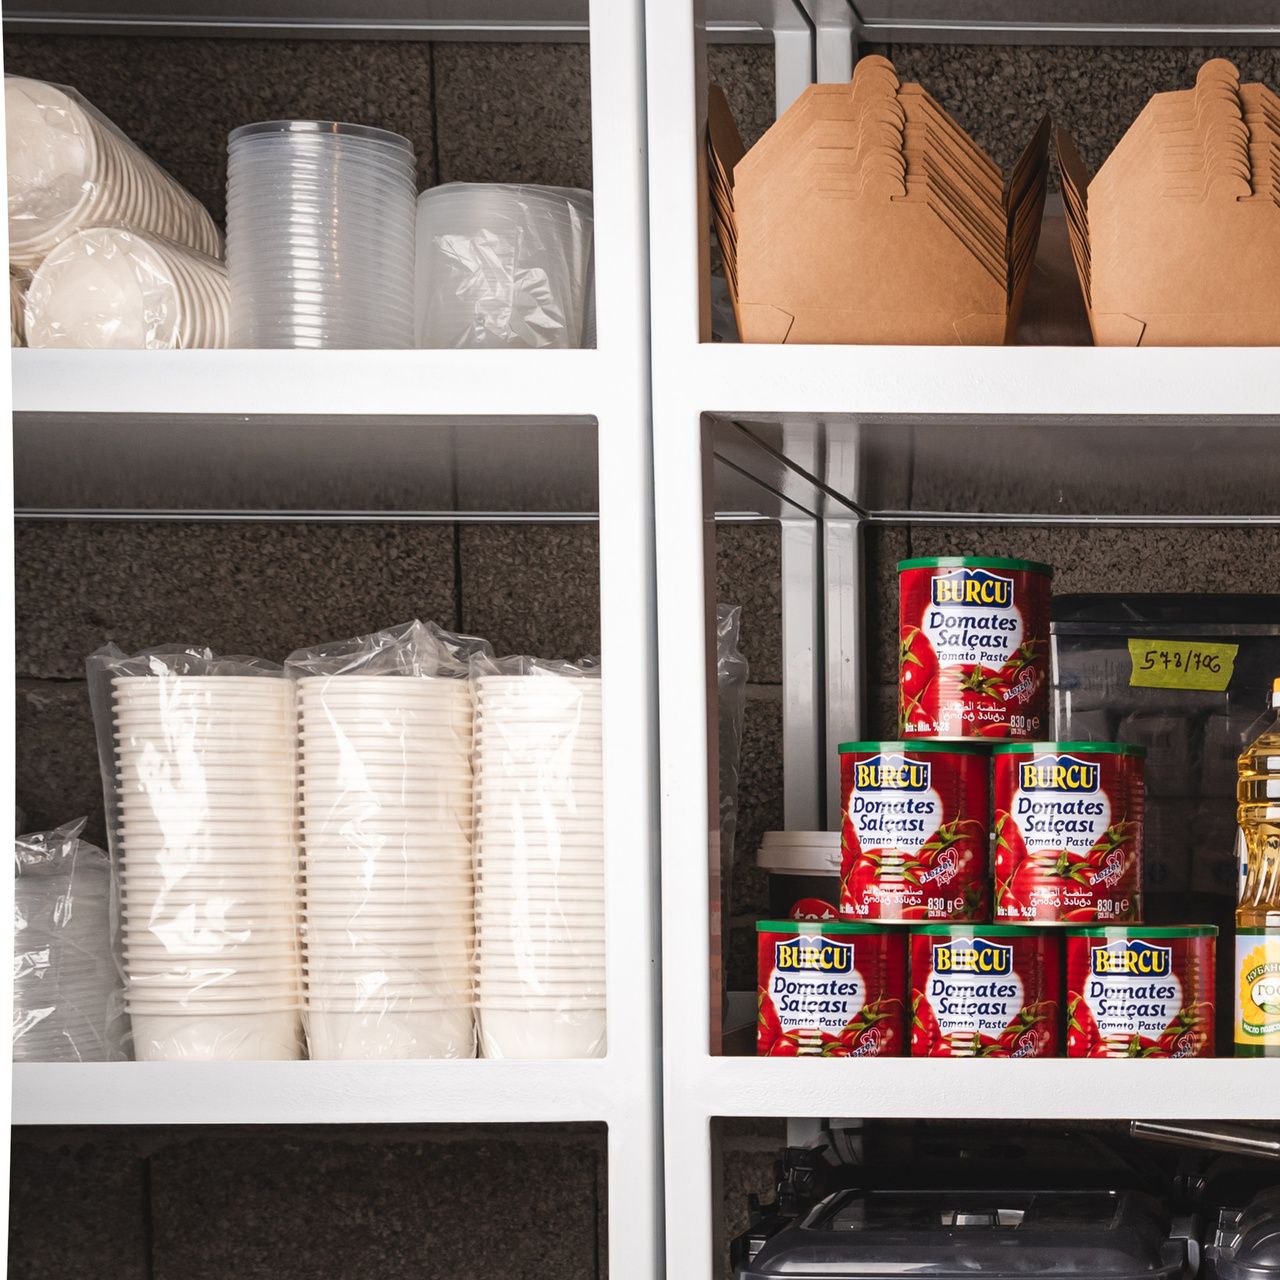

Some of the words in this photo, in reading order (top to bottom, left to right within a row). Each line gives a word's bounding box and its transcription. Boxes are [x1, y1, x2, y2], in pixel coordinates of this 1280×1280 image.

[936, 579, 1008, 604] BURCU
[930, 612, 1017, 632] Domates
[937, 630, 1008, 650] Salçası
[936, 651, 975, 661] Tomato
[980, 652, 1008, 662] Paste
[1010, 715, 1024, 727] 830
[857, 765, 923, 789] BURCU
[1024, 765, 1094, 789] BURCU
[853, 797, 935, 813] Domates
[1018, 797, 1104, 815] Domates
[1025, 815, 1094, 836] Salçası
[859, 835, 892, 845] Tomato
[896, 836, 925, 845] Paste
[1024, 836, 1062, 846] Tomato
[1066, 837, 1095, 846] Paste
[928, 897, 944, 910] 830
[1097, 899, 1112, 911] 830
[779, 946, 847, 970] BURCU
[937, 948, 1006, 973] BURCU
[1095, 950, 1165, 974] BURCU
[774, 976, 858, 996] Domates
[931, 979, 1017, 998] Domates
[1090, 981, 1175, 999] Domates
[780, 995, 848, 1016] Salçası
[938, 997, 1007, 1017] Salçası
[1097, 1000, 1166, 1020] Salçası
[779, 1015, 814, 1025] Tomato
[819, 1016, 848, 1027] Paste
[937, 1018, 974, 1028] Tomato
[978, 1019, 1008, 1029] Paste
[1096, 1020, 1134, 1029] Tomato
[1138, 1020, 1167, 1030] Paste
[1243, 1024, 1259, 1034] МАСЛО
